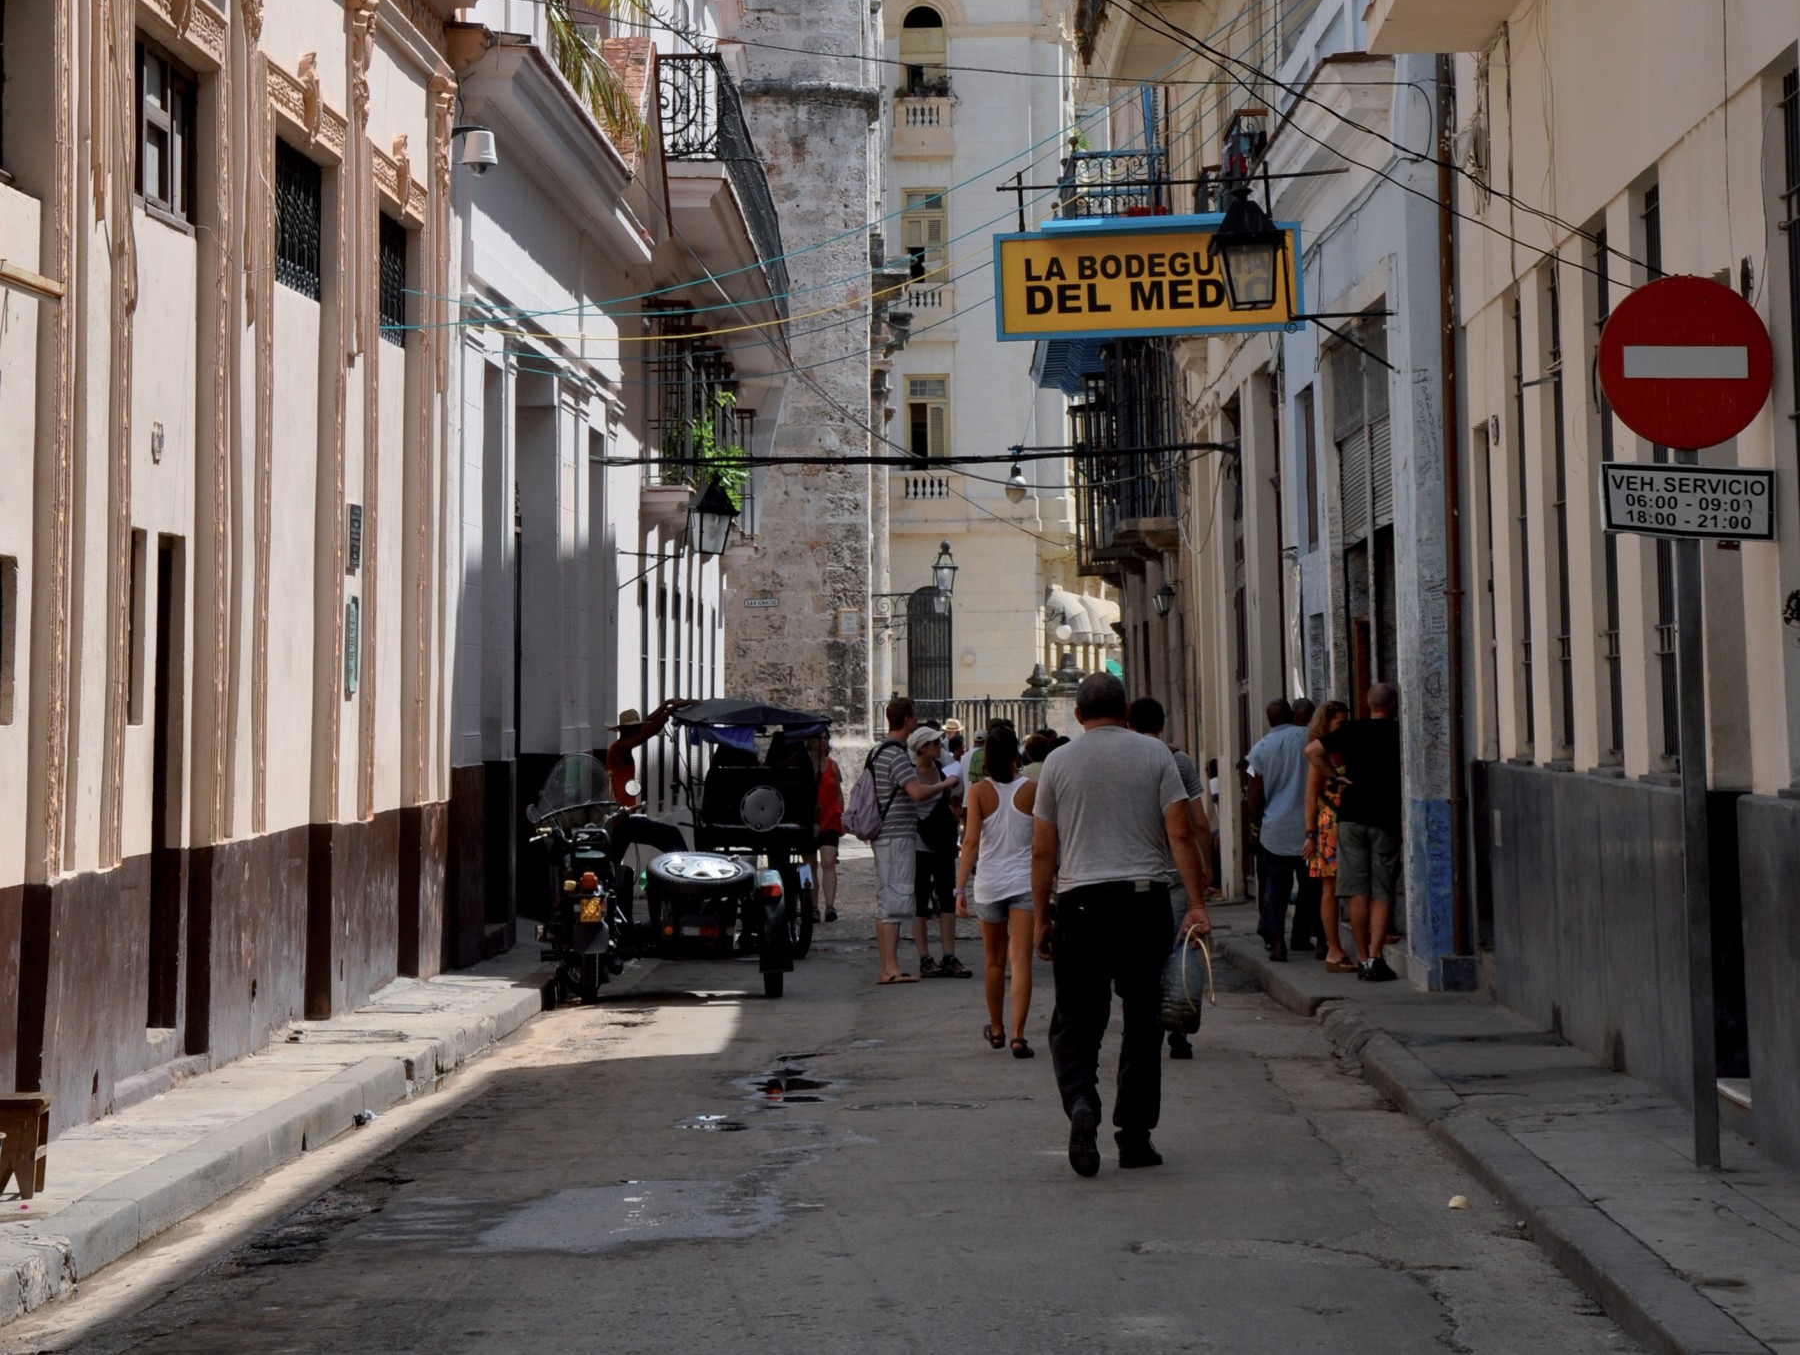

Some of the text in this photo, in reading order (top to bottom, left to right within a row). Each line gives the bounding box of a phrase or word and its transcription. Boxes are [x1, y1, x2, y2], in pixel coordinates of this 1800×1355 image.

[1024, 256, 1067, 282] LA
[1026, 284, 1112, 315] DEL
[1625, 493, 1678, 510] 06:00
[1699, 497, 1753, 512] 09:00
[1626, 510, 1677, 526] 18:00
[1697, 514, 1752, 530] 21:00
